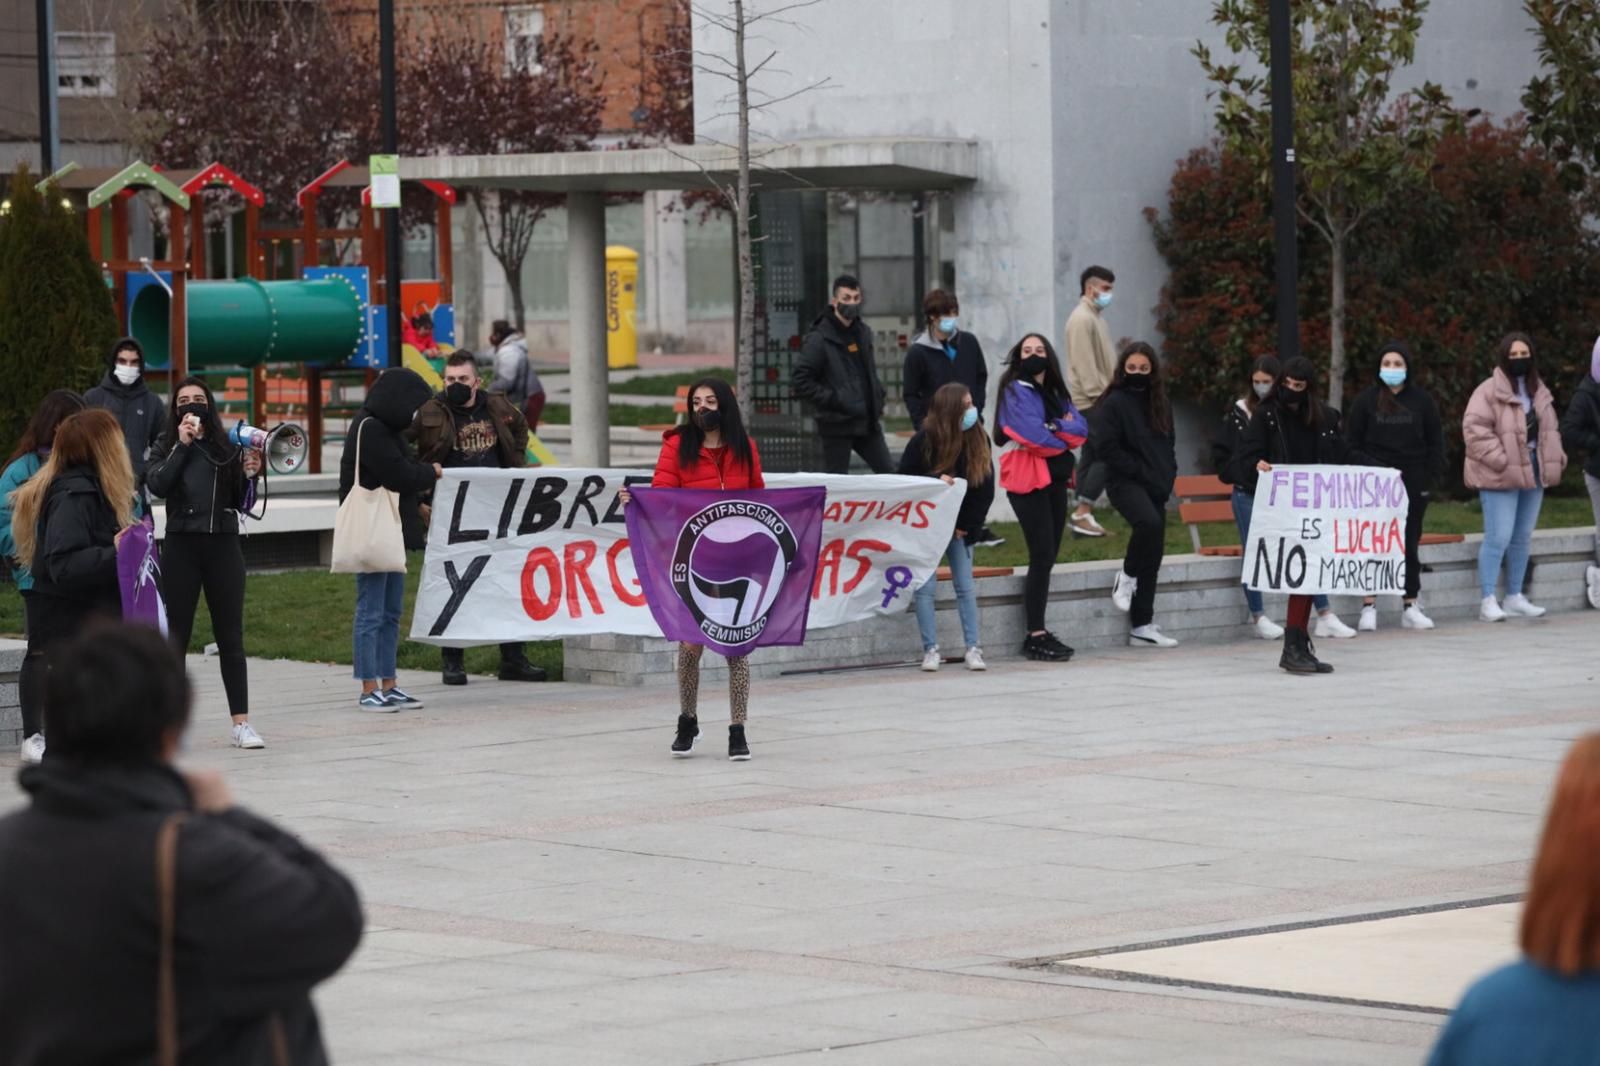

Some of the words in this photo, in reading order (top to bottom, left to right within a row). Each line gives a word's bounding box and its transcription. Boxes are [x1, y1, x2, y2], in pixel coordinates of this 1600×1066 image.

[1269, 471, 1404, 509] FEMINISMO
[689, 503, 785, 535] ANTIFASCISMO
[1301, 518, 1322, 540] ES
[1334, 517, 1406, 555] LUCHA
[674, 562, 687, 582] ES
[1251, 536, 1307, 589] NO
[1318, 556, 1406, 591] MARKETING
[428, 554, 492, 636] Y
[700, 615, 768, 642] FEMINISMO
